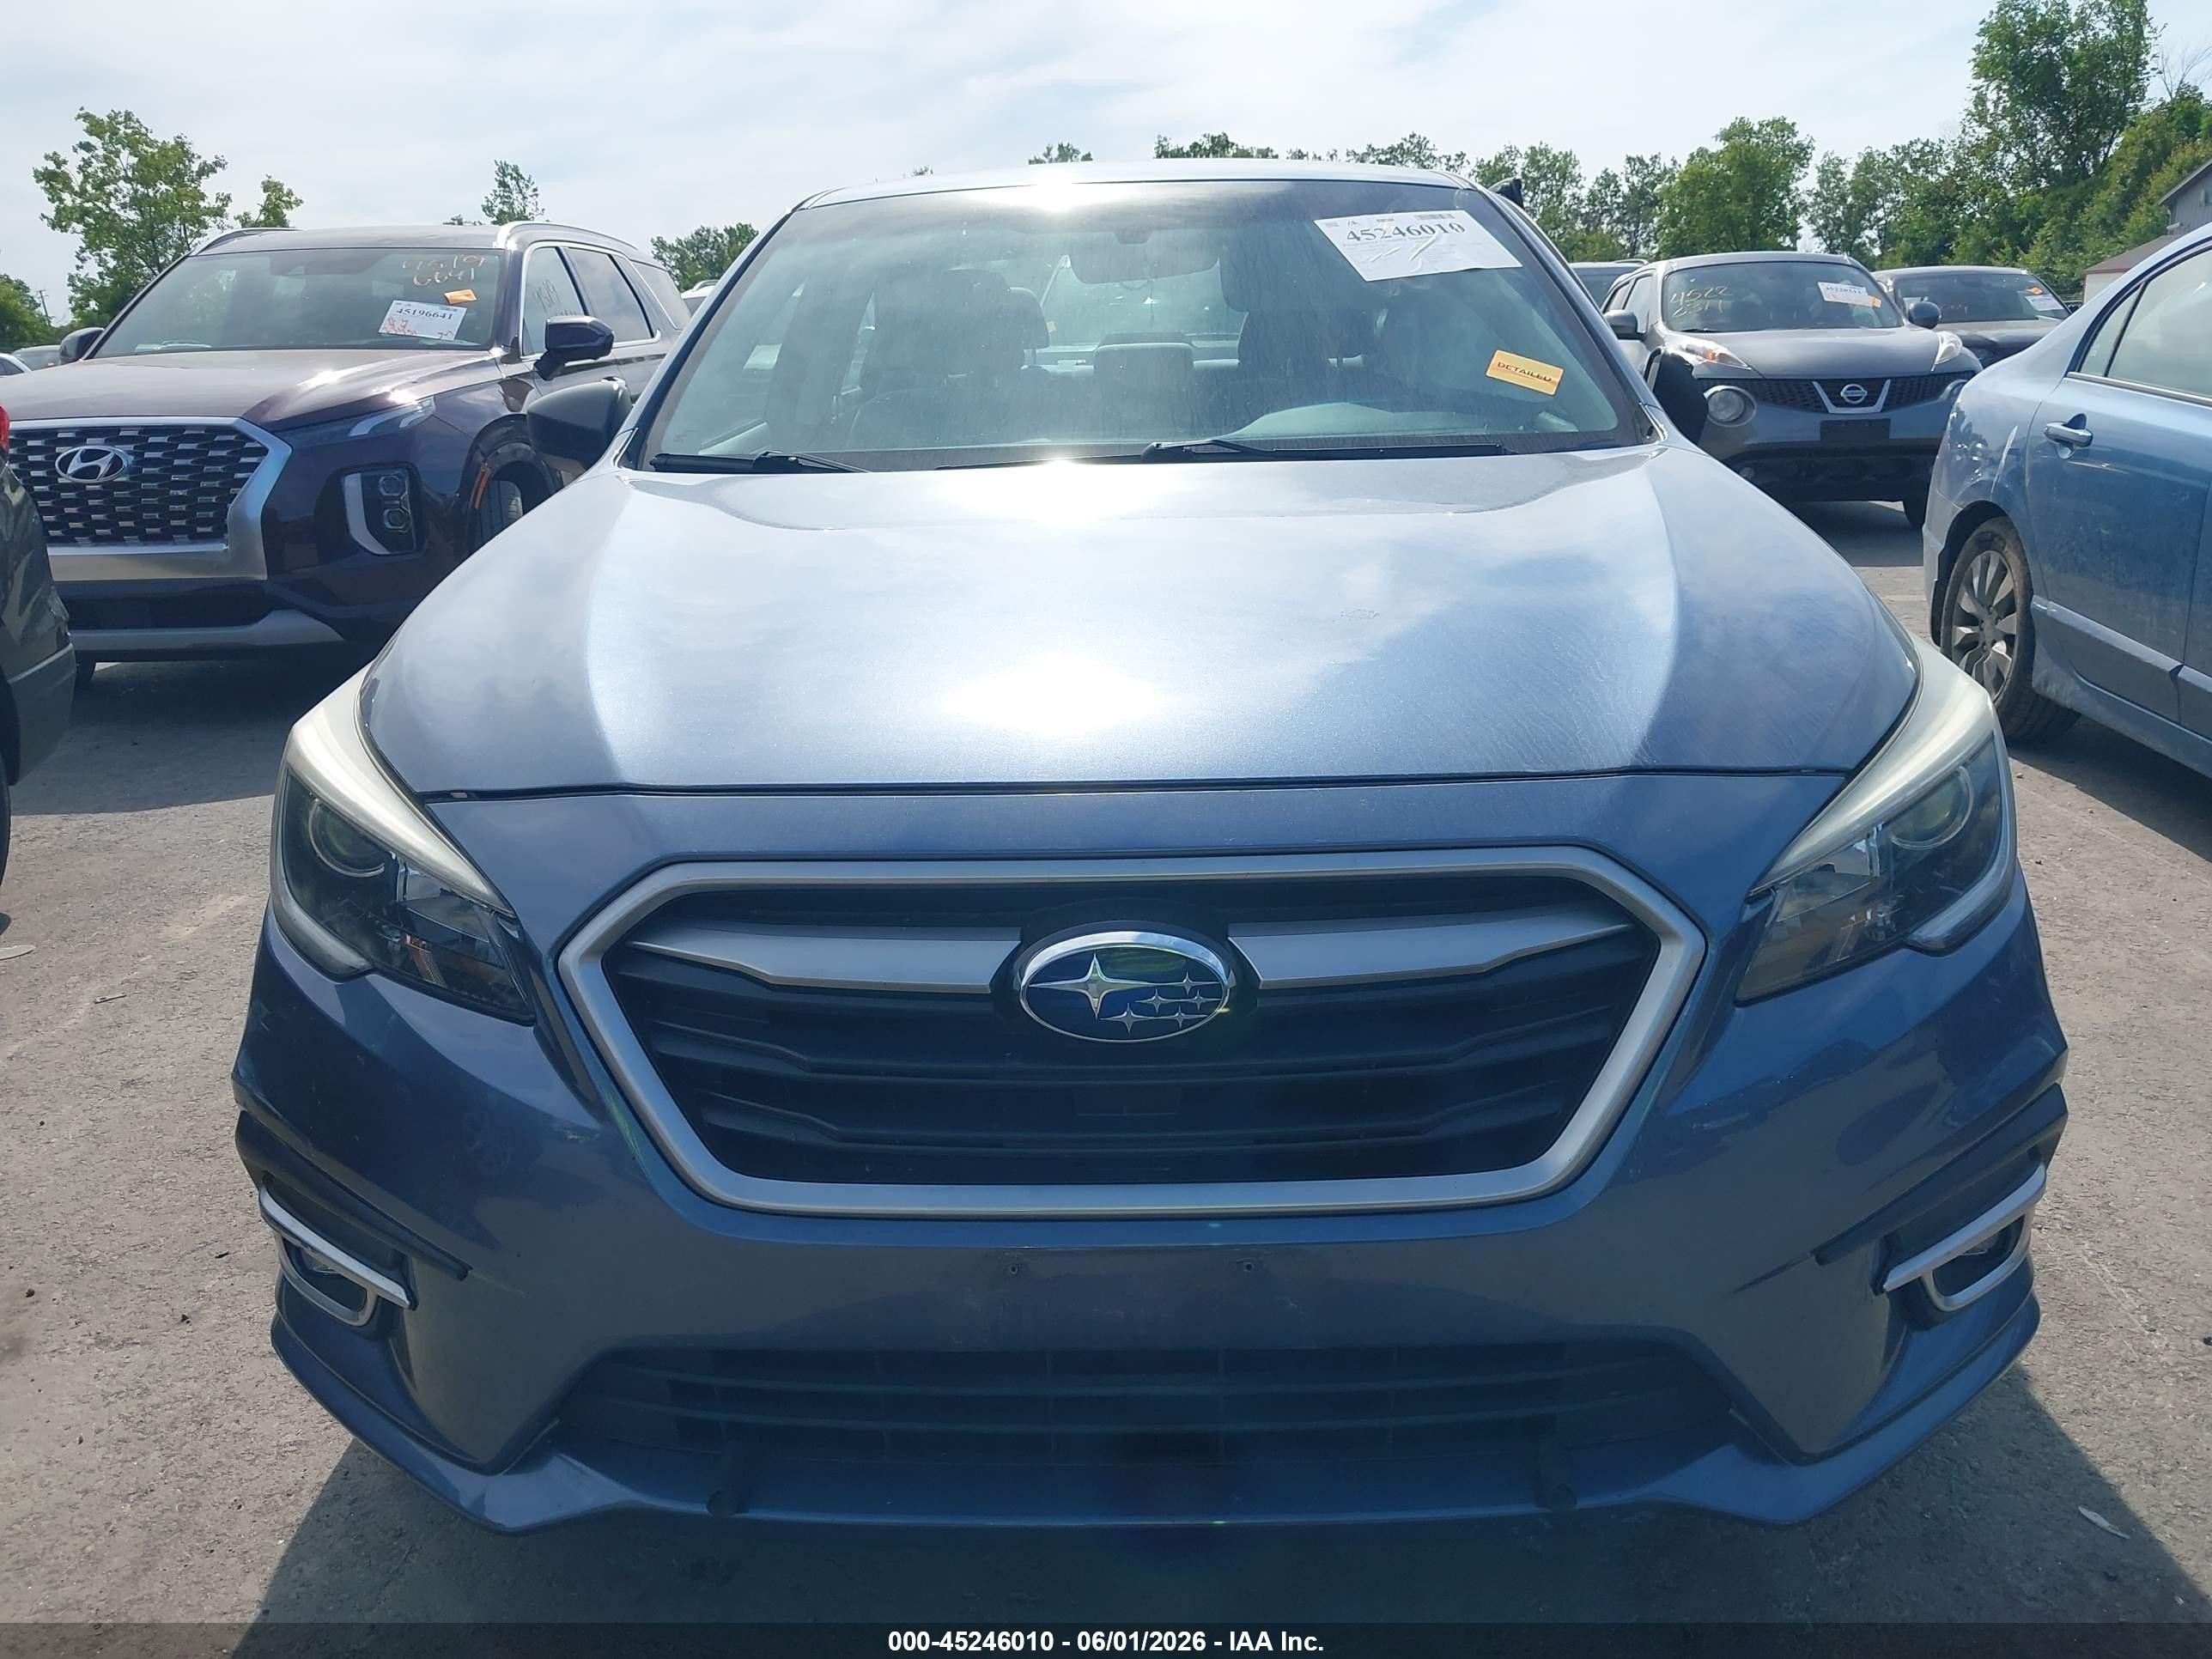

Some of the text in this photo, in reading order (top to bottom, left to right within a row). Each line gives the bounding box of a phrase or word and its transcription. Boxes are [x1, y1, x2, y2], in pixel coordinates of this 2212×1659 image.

[1346, 222, 1466, 242] 45246010
[396, 307, 453, 320] 45196641
[1497, 362, 1553, 382] DETAILED
